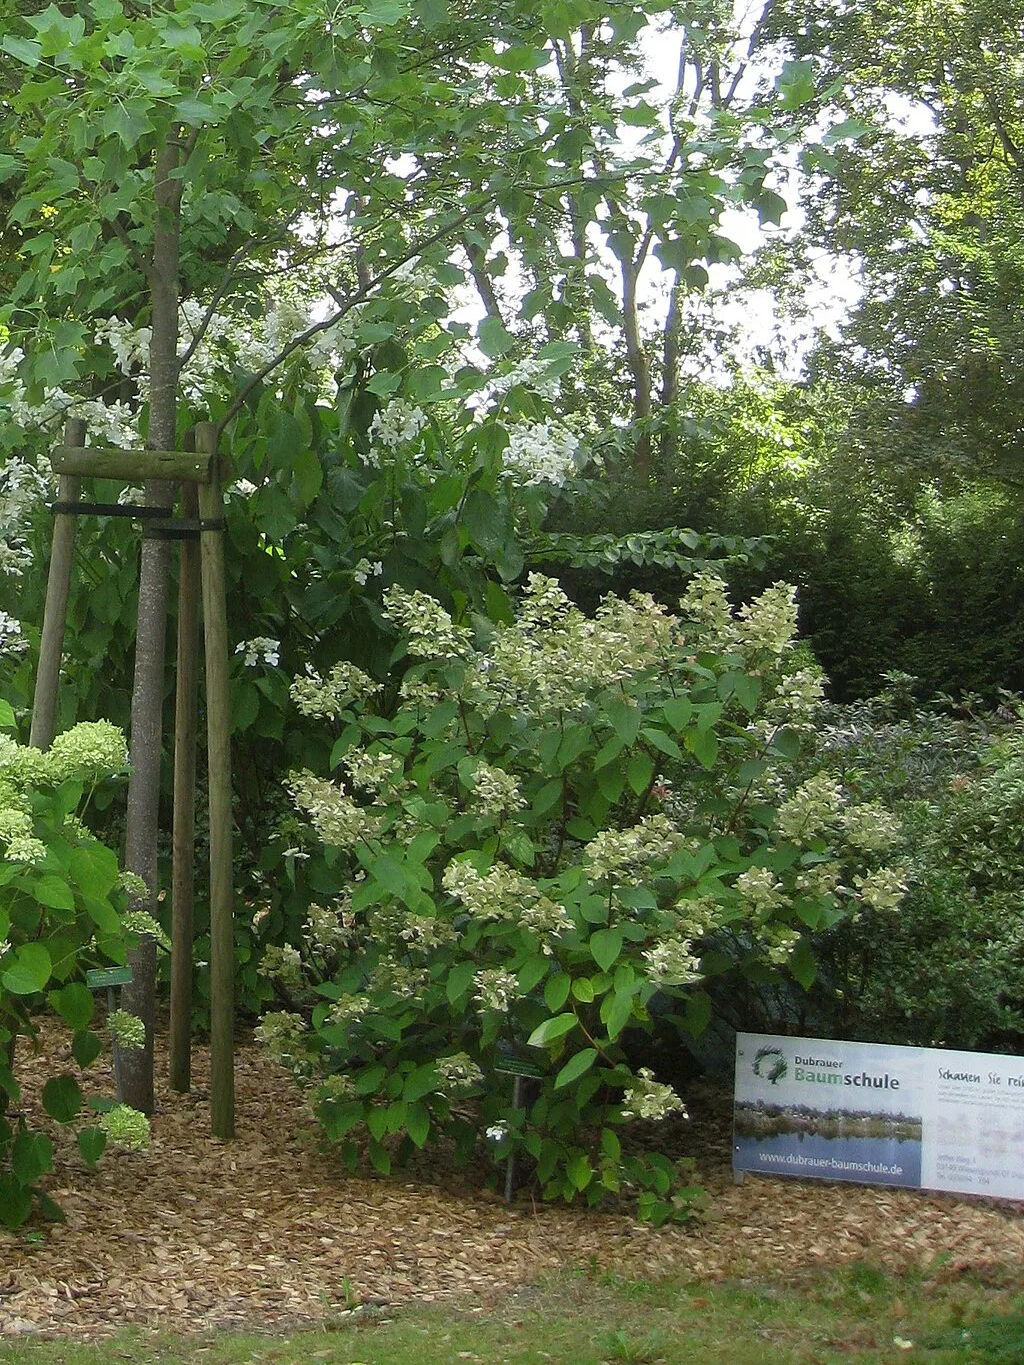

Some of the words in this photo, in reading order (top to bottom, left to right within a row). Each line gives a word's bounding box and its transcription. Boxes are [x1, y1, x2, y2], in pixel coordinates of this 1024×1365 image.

[794, 1056, 843, 1068] Dubrauer
[794, 1067, 900, 1090] Baumschule
[938, 1067, 981, 1083] Schauen
[988, 1072, 1001, 1084] Sie
[759, 1152, 903, 1175] www.dubrauer-baumschule.de
